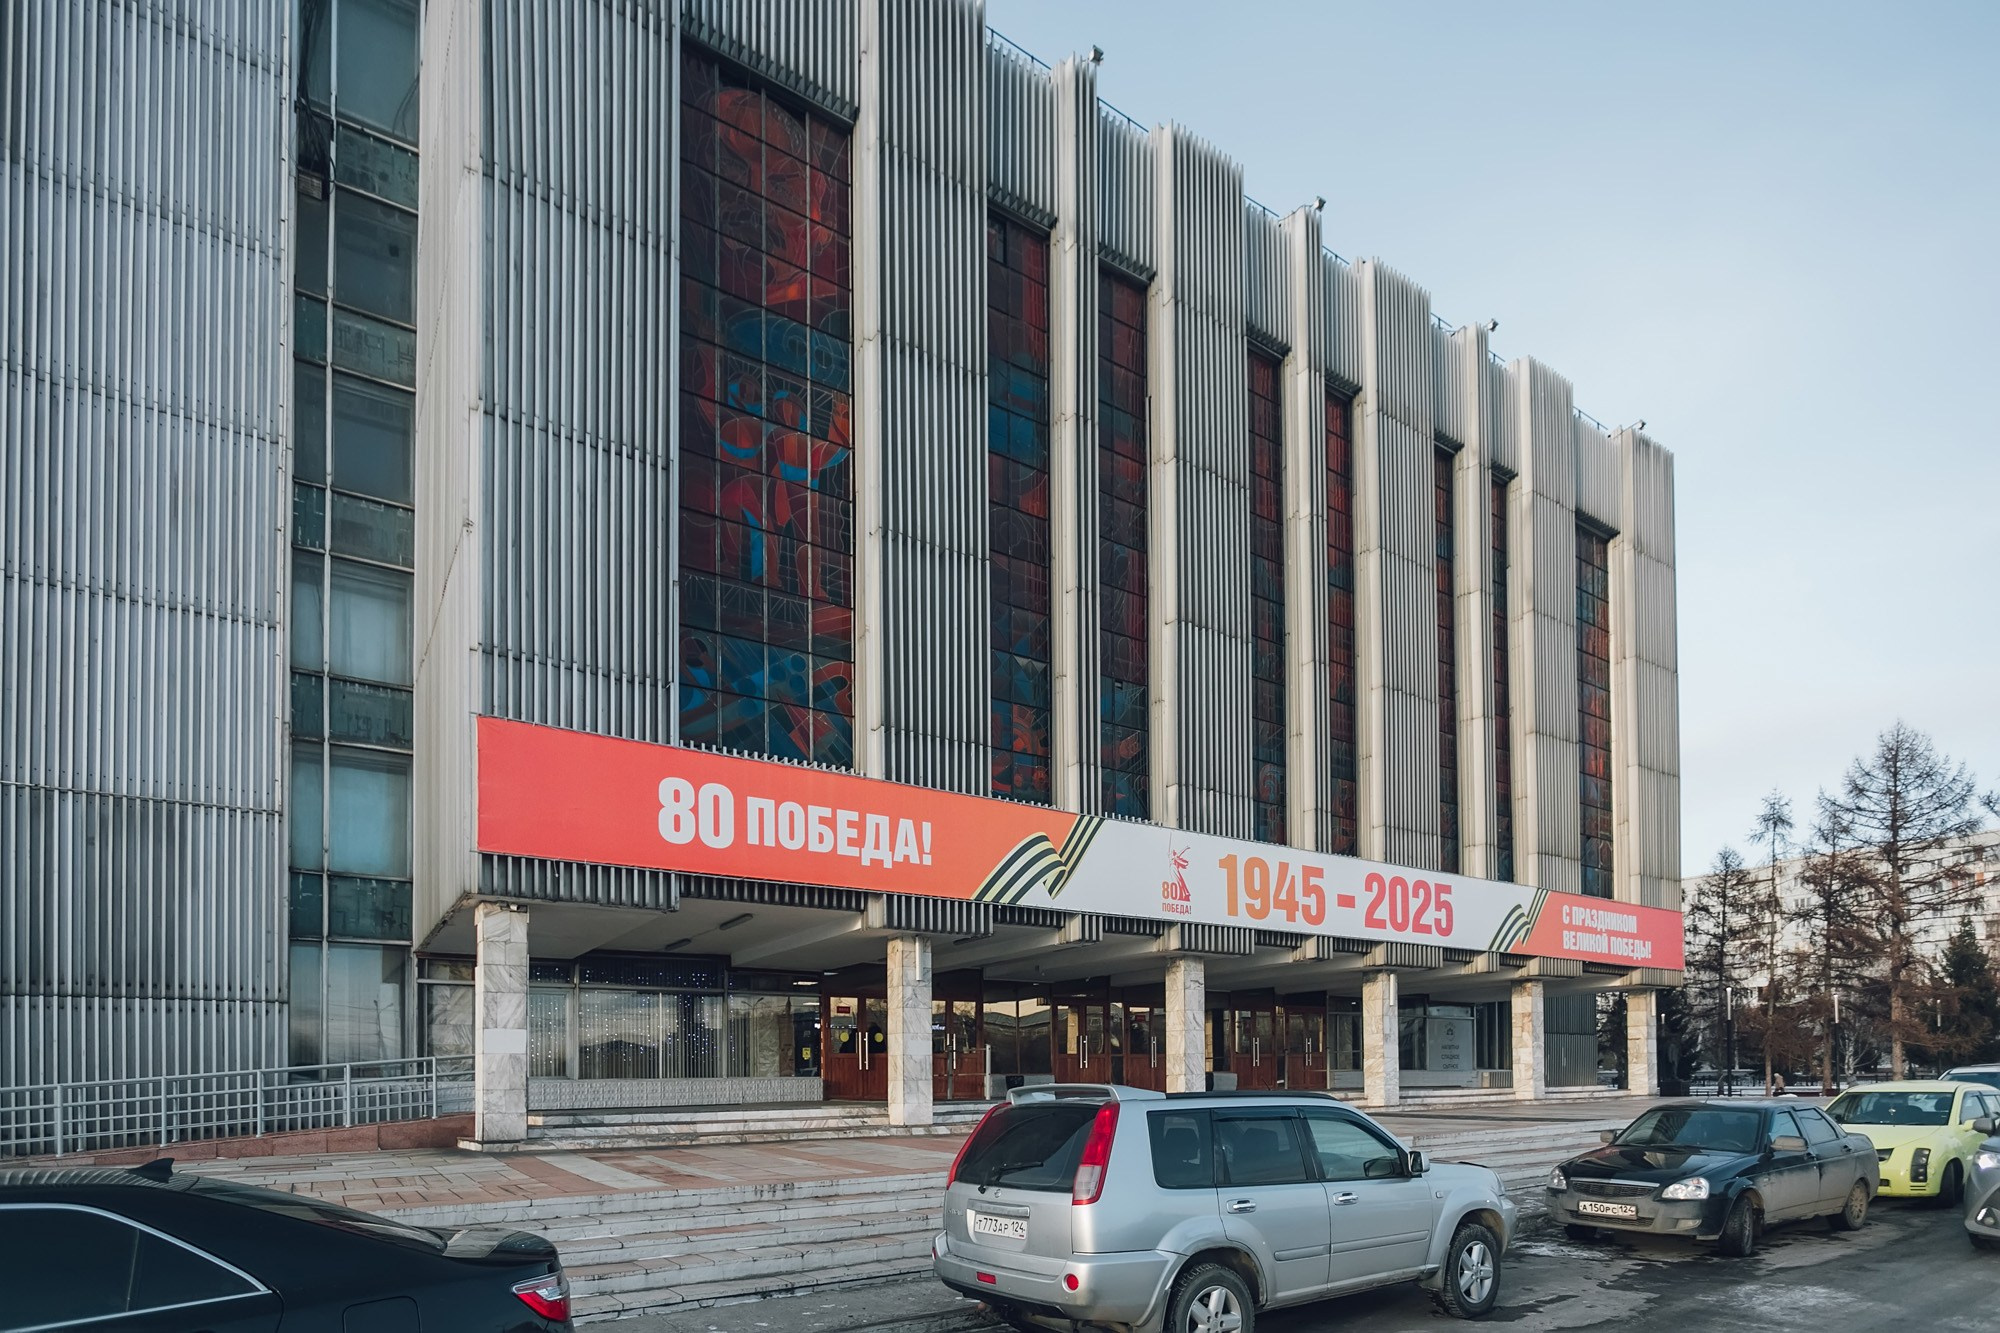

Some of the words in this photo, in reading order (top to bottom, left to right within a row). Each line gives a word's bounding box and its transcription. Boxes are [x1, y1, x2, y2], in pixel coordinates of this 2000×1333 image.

[658, 776, 735, 849] 80
[747, 796, 932, 868] ПОБЕДА!
[1162, 881, 1178, 900] 80
[1218, 853, 1326, 926] 1945
[1364, 872, 1454, 937] 2025
[1162, 902, 1192, 915] ПОБЕДА!
[1562, 904, 1570, 925] С
[1572, 906, 1637, 933] ПРАЗДНИКОМ
[1563, 930, 1608, 954] ВЕЛИКОЙ
[1610, 936, 1652, 960] ПОБЕДЫ!
